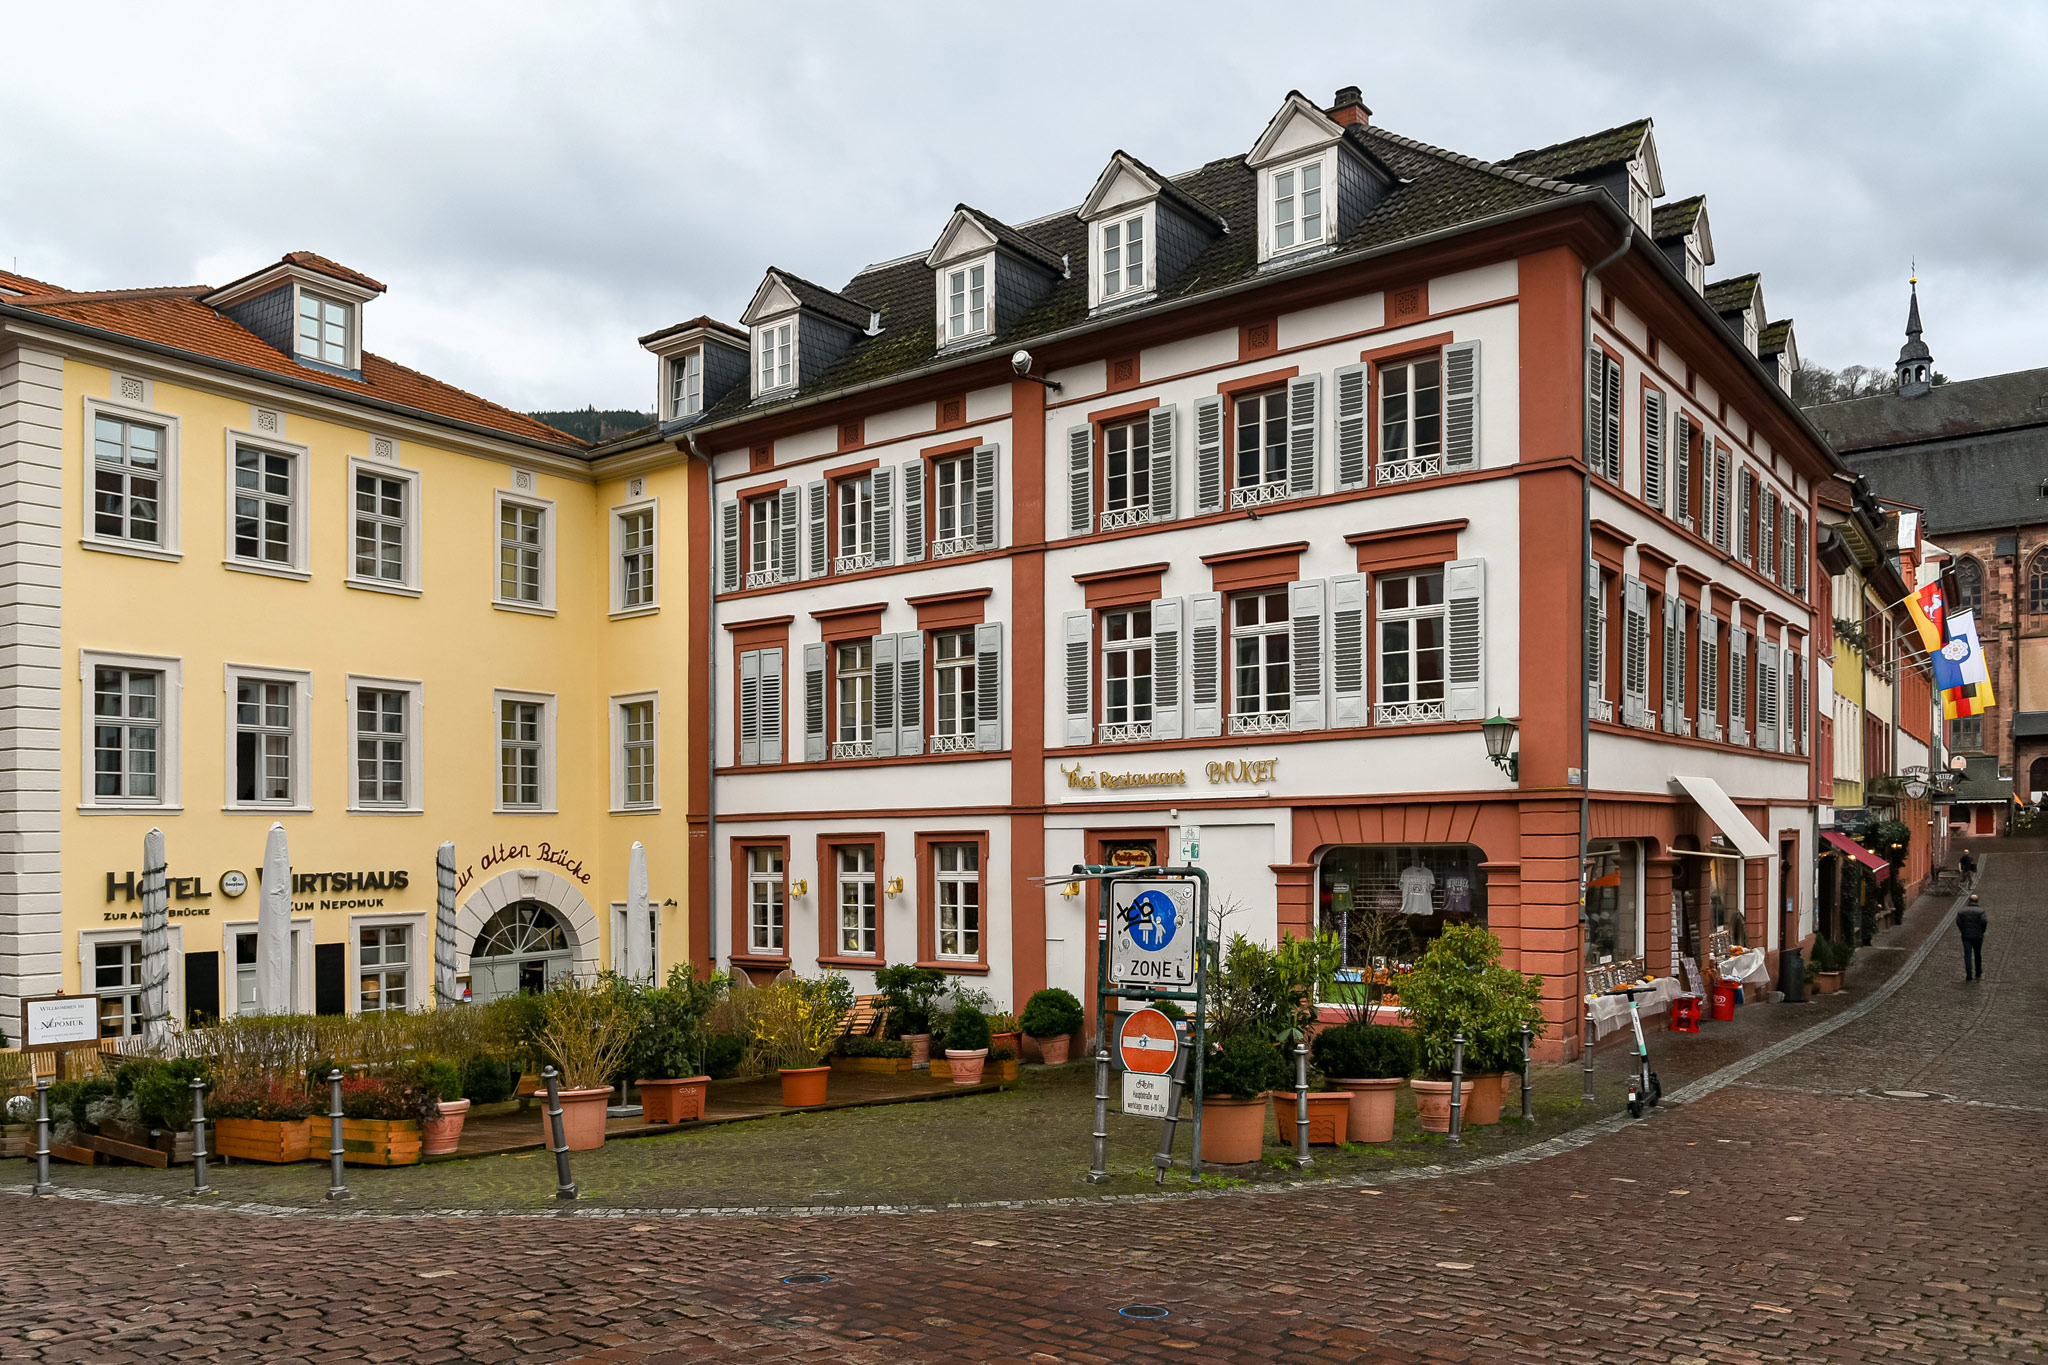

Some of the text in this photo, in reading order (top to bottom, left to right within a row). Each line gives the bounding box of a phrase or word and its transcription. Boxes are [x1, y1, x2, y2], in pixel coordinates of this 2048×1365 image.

[1060, 762, 1186, 788] Thai Restaurant
[1205, 757, 1278, 785] PHUKET
[1901, 766, 1930, 776] HOTEL
[481, 843, 531, 870] alten
[537, 842, 591, 884] Brücke
[168, 908, 211, 917] BRÜCKE
[320, 899, 384, 910] NEPOMUK
[1131, 960, 1171, 977] ZONE
